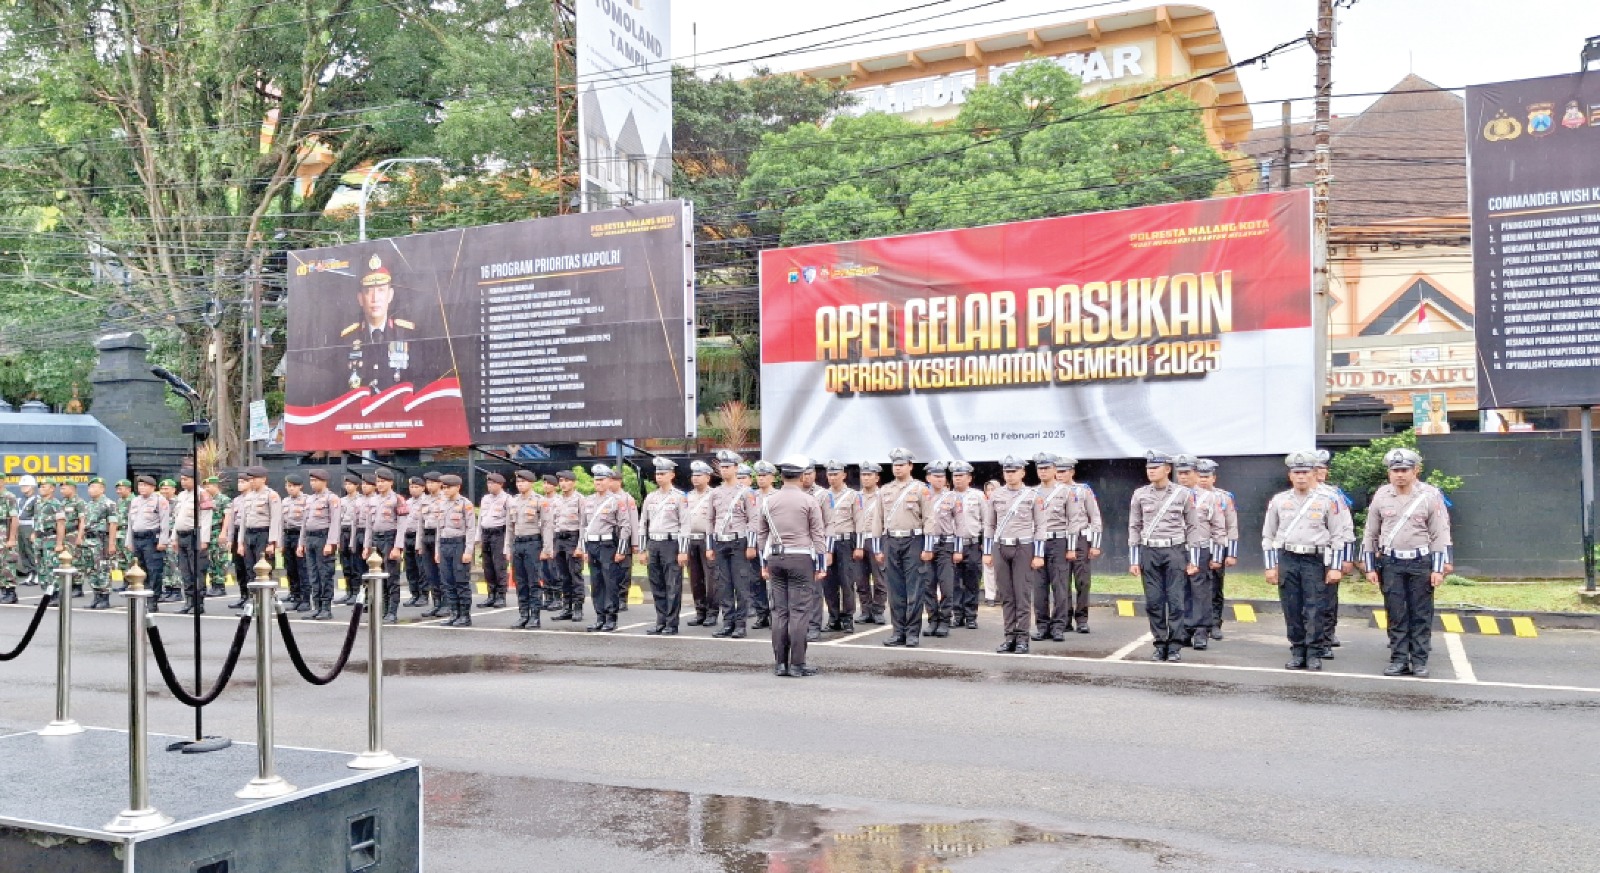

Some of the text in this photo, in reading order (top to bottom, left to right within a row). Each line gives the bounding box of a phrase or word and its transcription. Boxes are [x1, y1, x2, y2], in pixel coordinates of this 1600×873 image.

[1488, 192, 1558, 211] COMMANDER
[1560, 188, 1589, 204] WISH
[1188, 223, 1236, 236] MALANG
[1238, 219, 1270, 230] KOTA
[491, 260, 533, 278] PROGRAM
[535, 254, 580, 273] PRIORITAS
[582, 249, 620, 268] KAPOLRI
[815, 269, 1233, 361] APEL GELAR PASUKAN
[825, 340, 1222, 393] OPERASI KESELAMATAN SEMERU 2025
[1326, 367, 1476, 387] SUD Dr. SAIFU
[1001, 430, 1040, 440] Februari
[1042, 430, 1065, 439] 2025
[4, 455, 91, 474] POLISI
